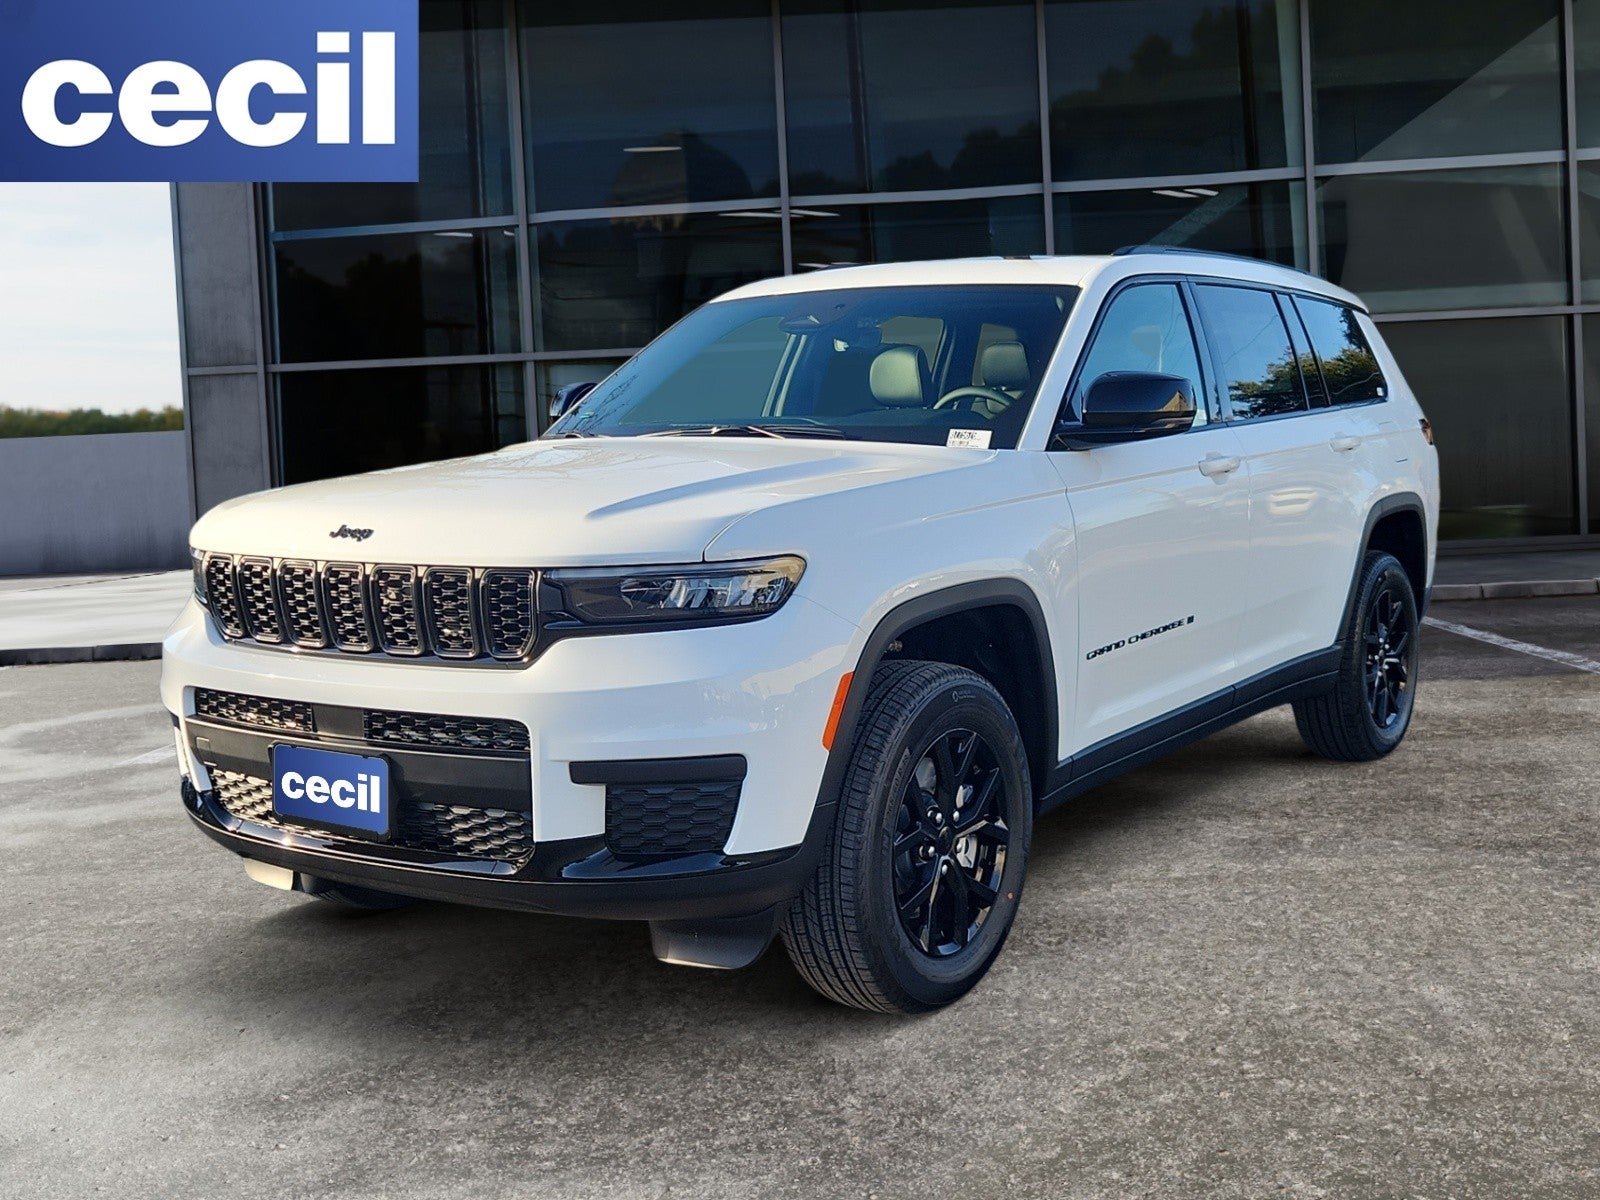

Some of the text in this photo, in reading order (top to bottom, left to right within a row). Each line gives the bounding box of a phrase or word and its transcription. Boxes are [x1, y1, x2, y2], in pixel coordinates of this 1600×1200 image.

[329, 524, 375, 542] Jeep
[1086, 640, 1126, 661] GRAND
[1128, 618, 1185, 644] CHEROKEE
[281, 771, 381, 814] cecil
